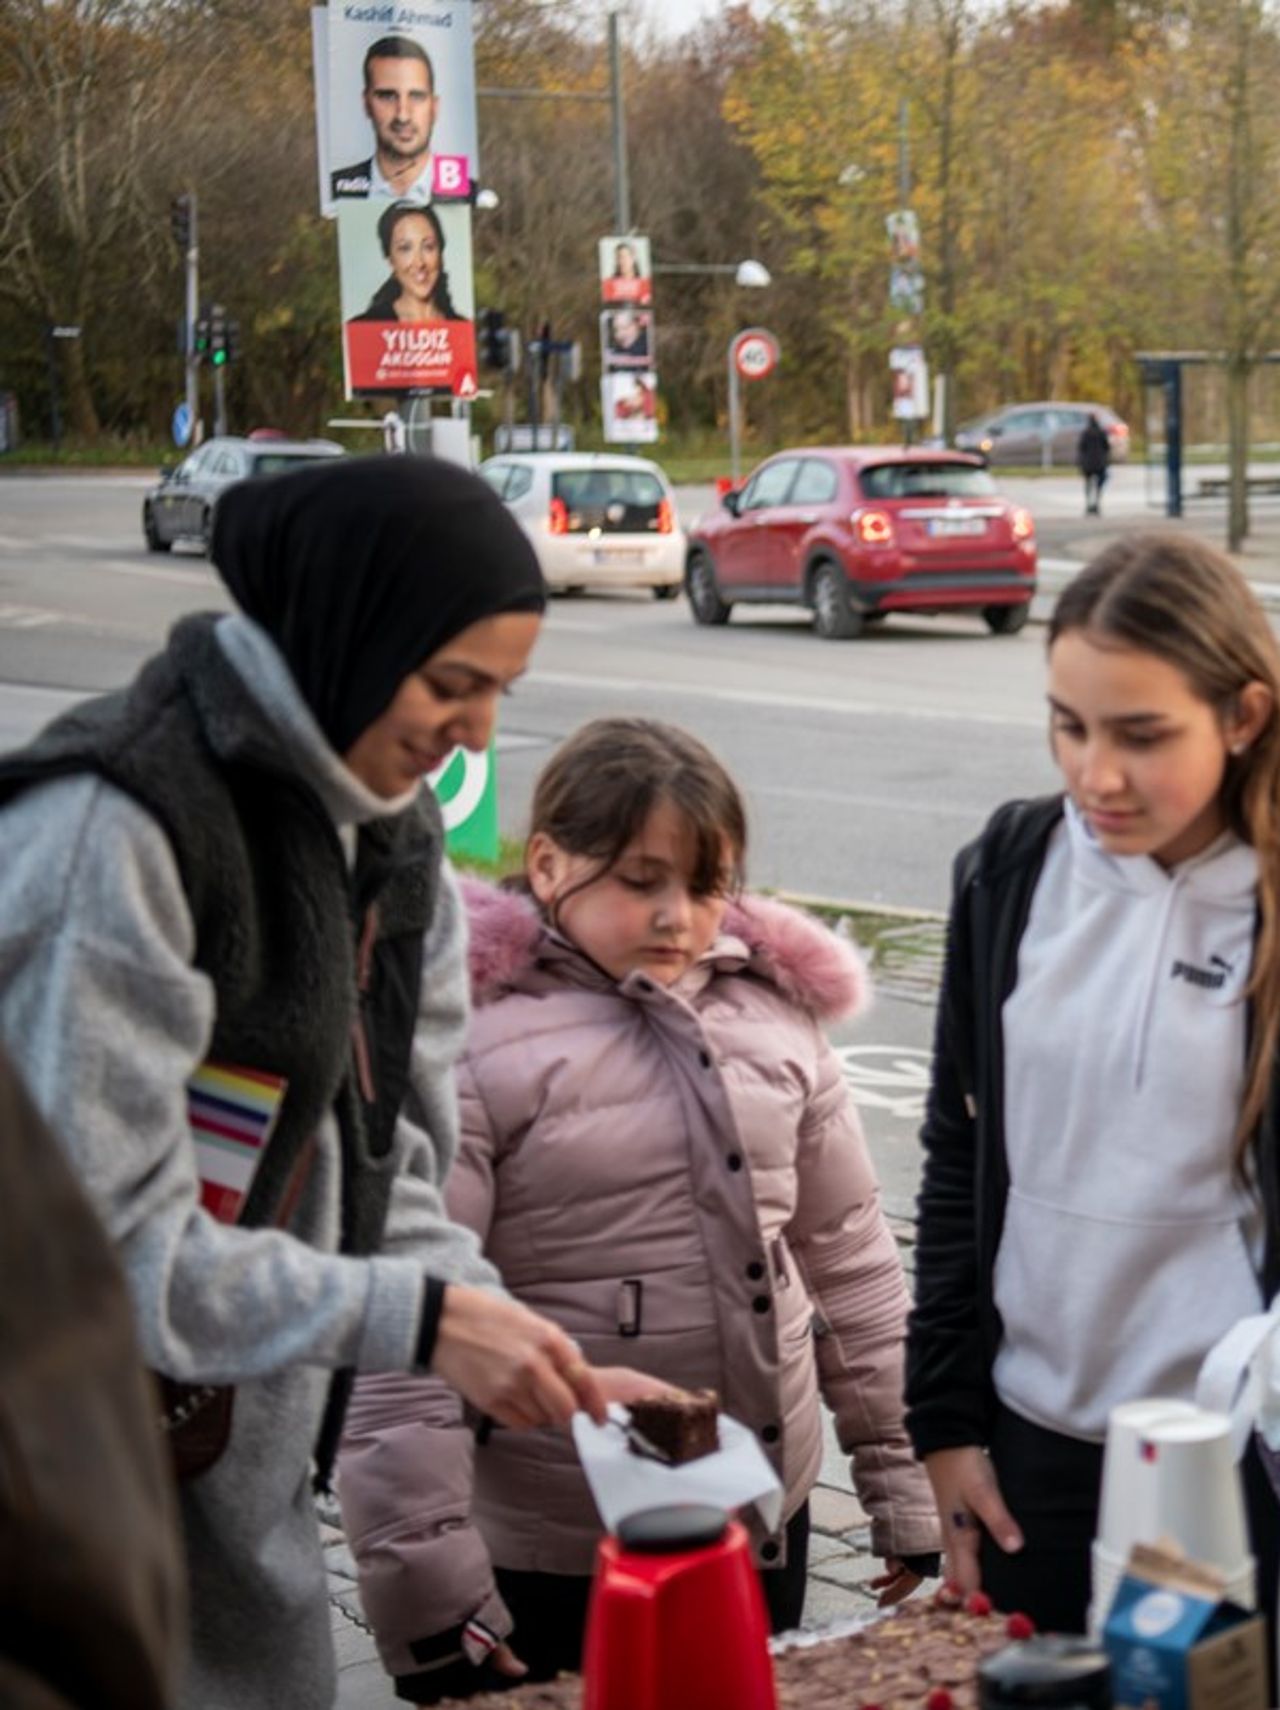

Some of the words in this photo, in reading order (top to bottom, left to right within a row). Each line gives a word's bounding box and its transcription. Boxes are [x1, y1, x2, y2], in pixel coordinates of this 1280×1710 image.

[397, 9, 452, 27] Ahmad
[438, 159, 462, 190] B
[382, 328, 451, 351] YILDIZ
[460, 371, 477, 395] A
[1170, 959, 1226, 990] PUMA
